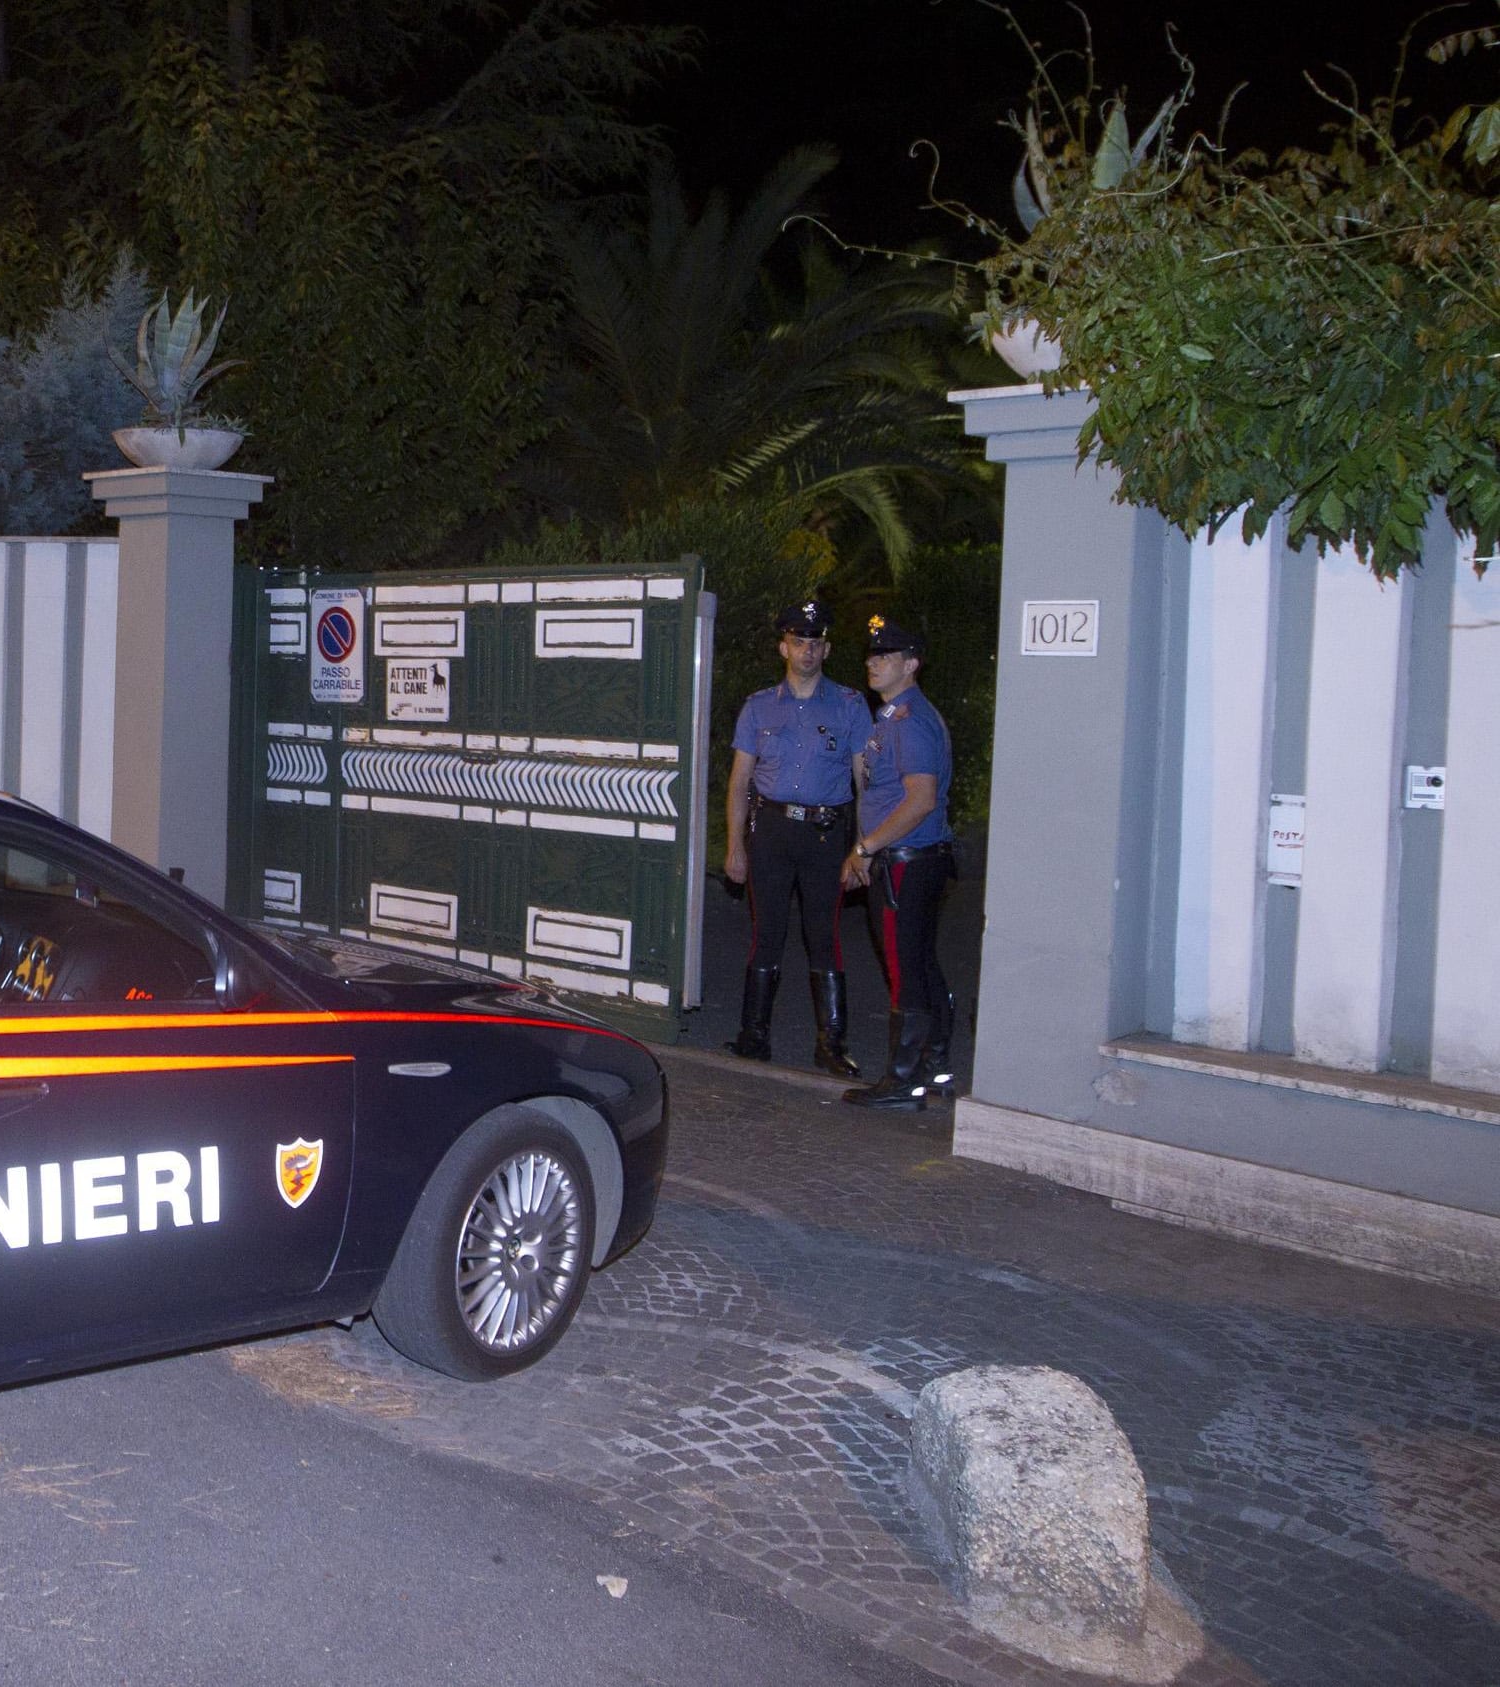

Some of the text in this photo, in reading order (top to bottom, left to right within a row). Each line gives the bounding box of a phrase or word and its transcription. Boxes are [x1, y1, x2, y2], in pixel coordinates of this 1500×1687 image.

[1031, 611, 1088, 644] 1012
[321, 667, 351, 678] PASSO
[391, 667, 428, 680] ATTENTI
[313, 679, 361, 690] CARRABILE
[390, 682, 428, 695] AL CANE
